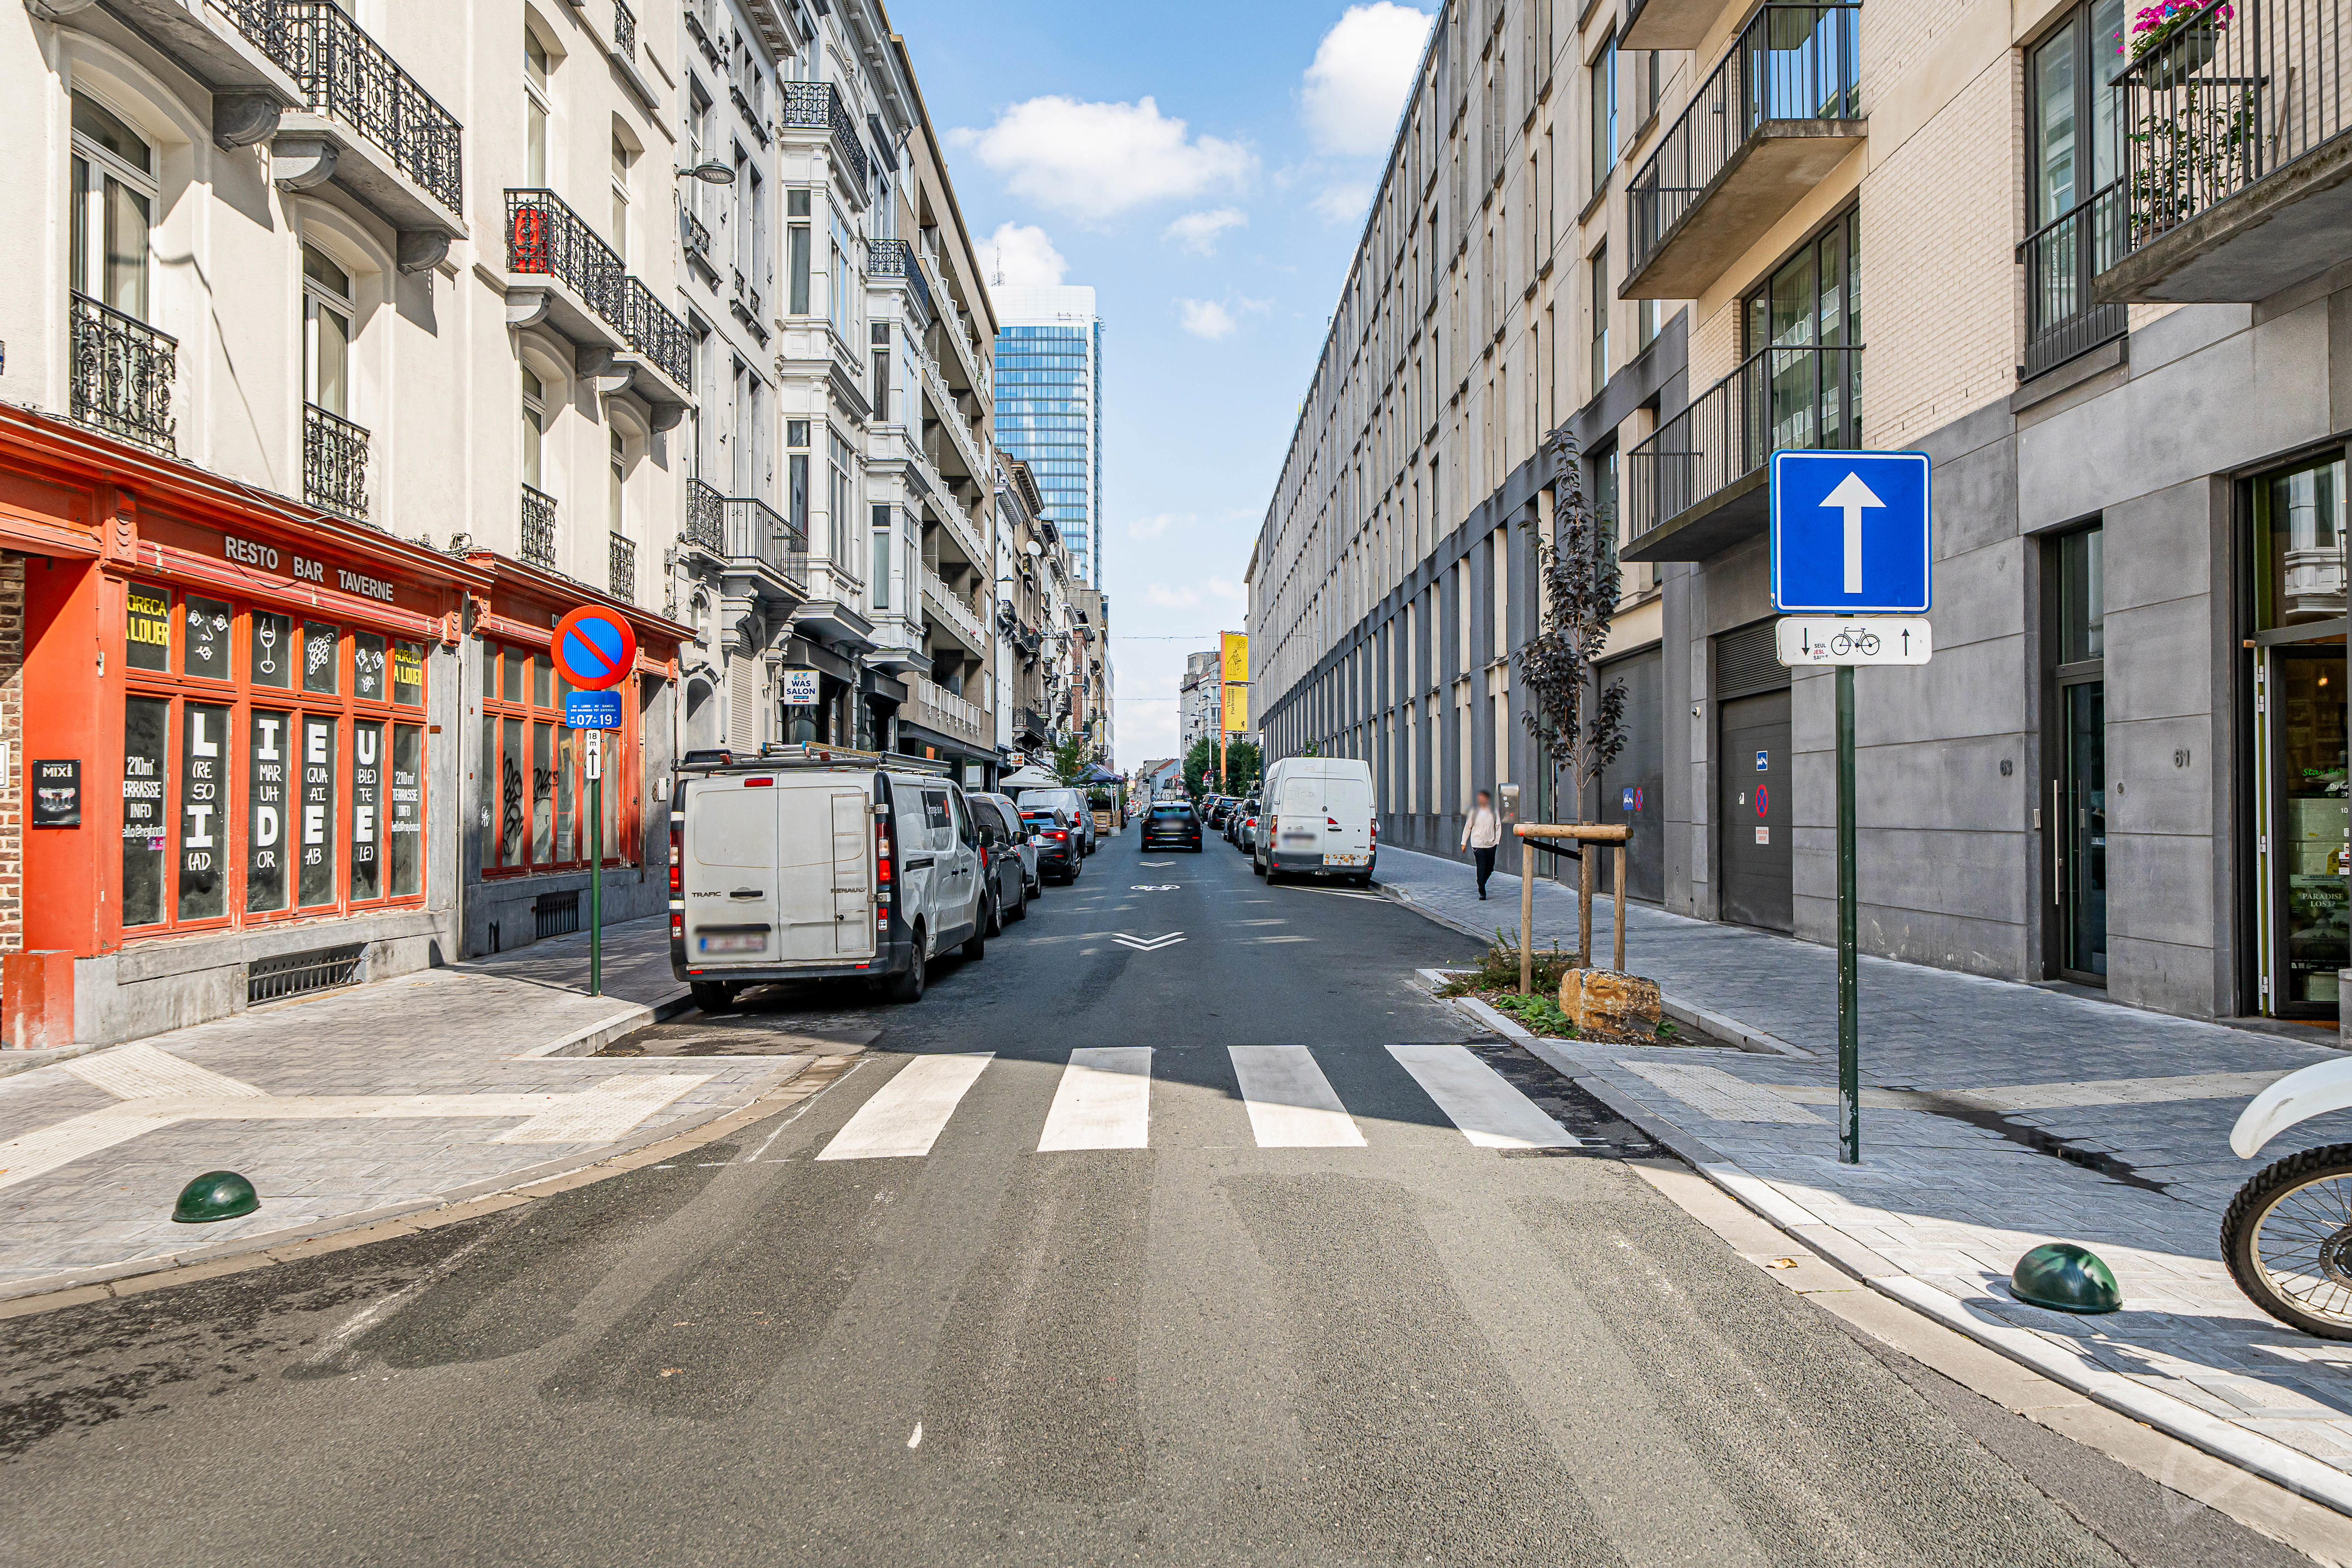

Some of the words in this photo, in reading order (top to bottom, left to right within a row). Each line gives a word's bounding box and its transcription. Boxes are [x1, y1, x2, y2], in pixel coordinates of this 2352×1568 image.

[225, 536, 278, 569] RESTO
[294, 556, 324, 583] BAR
[336, 569, 394, 601] TAVERNE
[127, 594, 167, 617] ORECA
[130, 617, 170, 646] LOUER
[395, 648, 421, 665] HORECA
[401, 666, 423, 686] LOUER
[577, 714, 593, 725] 07
[599, 714, 612, 725] 19
[193, 712, 218, 757] L
[258, 719, 279, 760] I
[308, 723, 328, 764] E
[357, 729, 376, 765] U
[2174, 748, 2190, 768] 61
[43, 767, 67, 777] MIX
[259, 764, 283, 781] MAR
[307, 767, 328, 783] QUA
[122, 781, 162, 798] ERRASSE
[192, 783, 215, 800] SO
[260, 786, 280, 801] UH
[310, 787, 327, 801] AI
[359, 788, 373, 802] TE
[392, 788, 418, 801] TERRASSE
[130, 804, 152, 818] INFO
[398, 805, 411, 817] INFO
[186, 805, 213, 848] I
[257, 806, 279, 847] D
[305, 805, 325, 844] E
[356, 805, 374, 842] E
[257, 851, 276, 868] OR
[305, 848, 322, 865] AB
